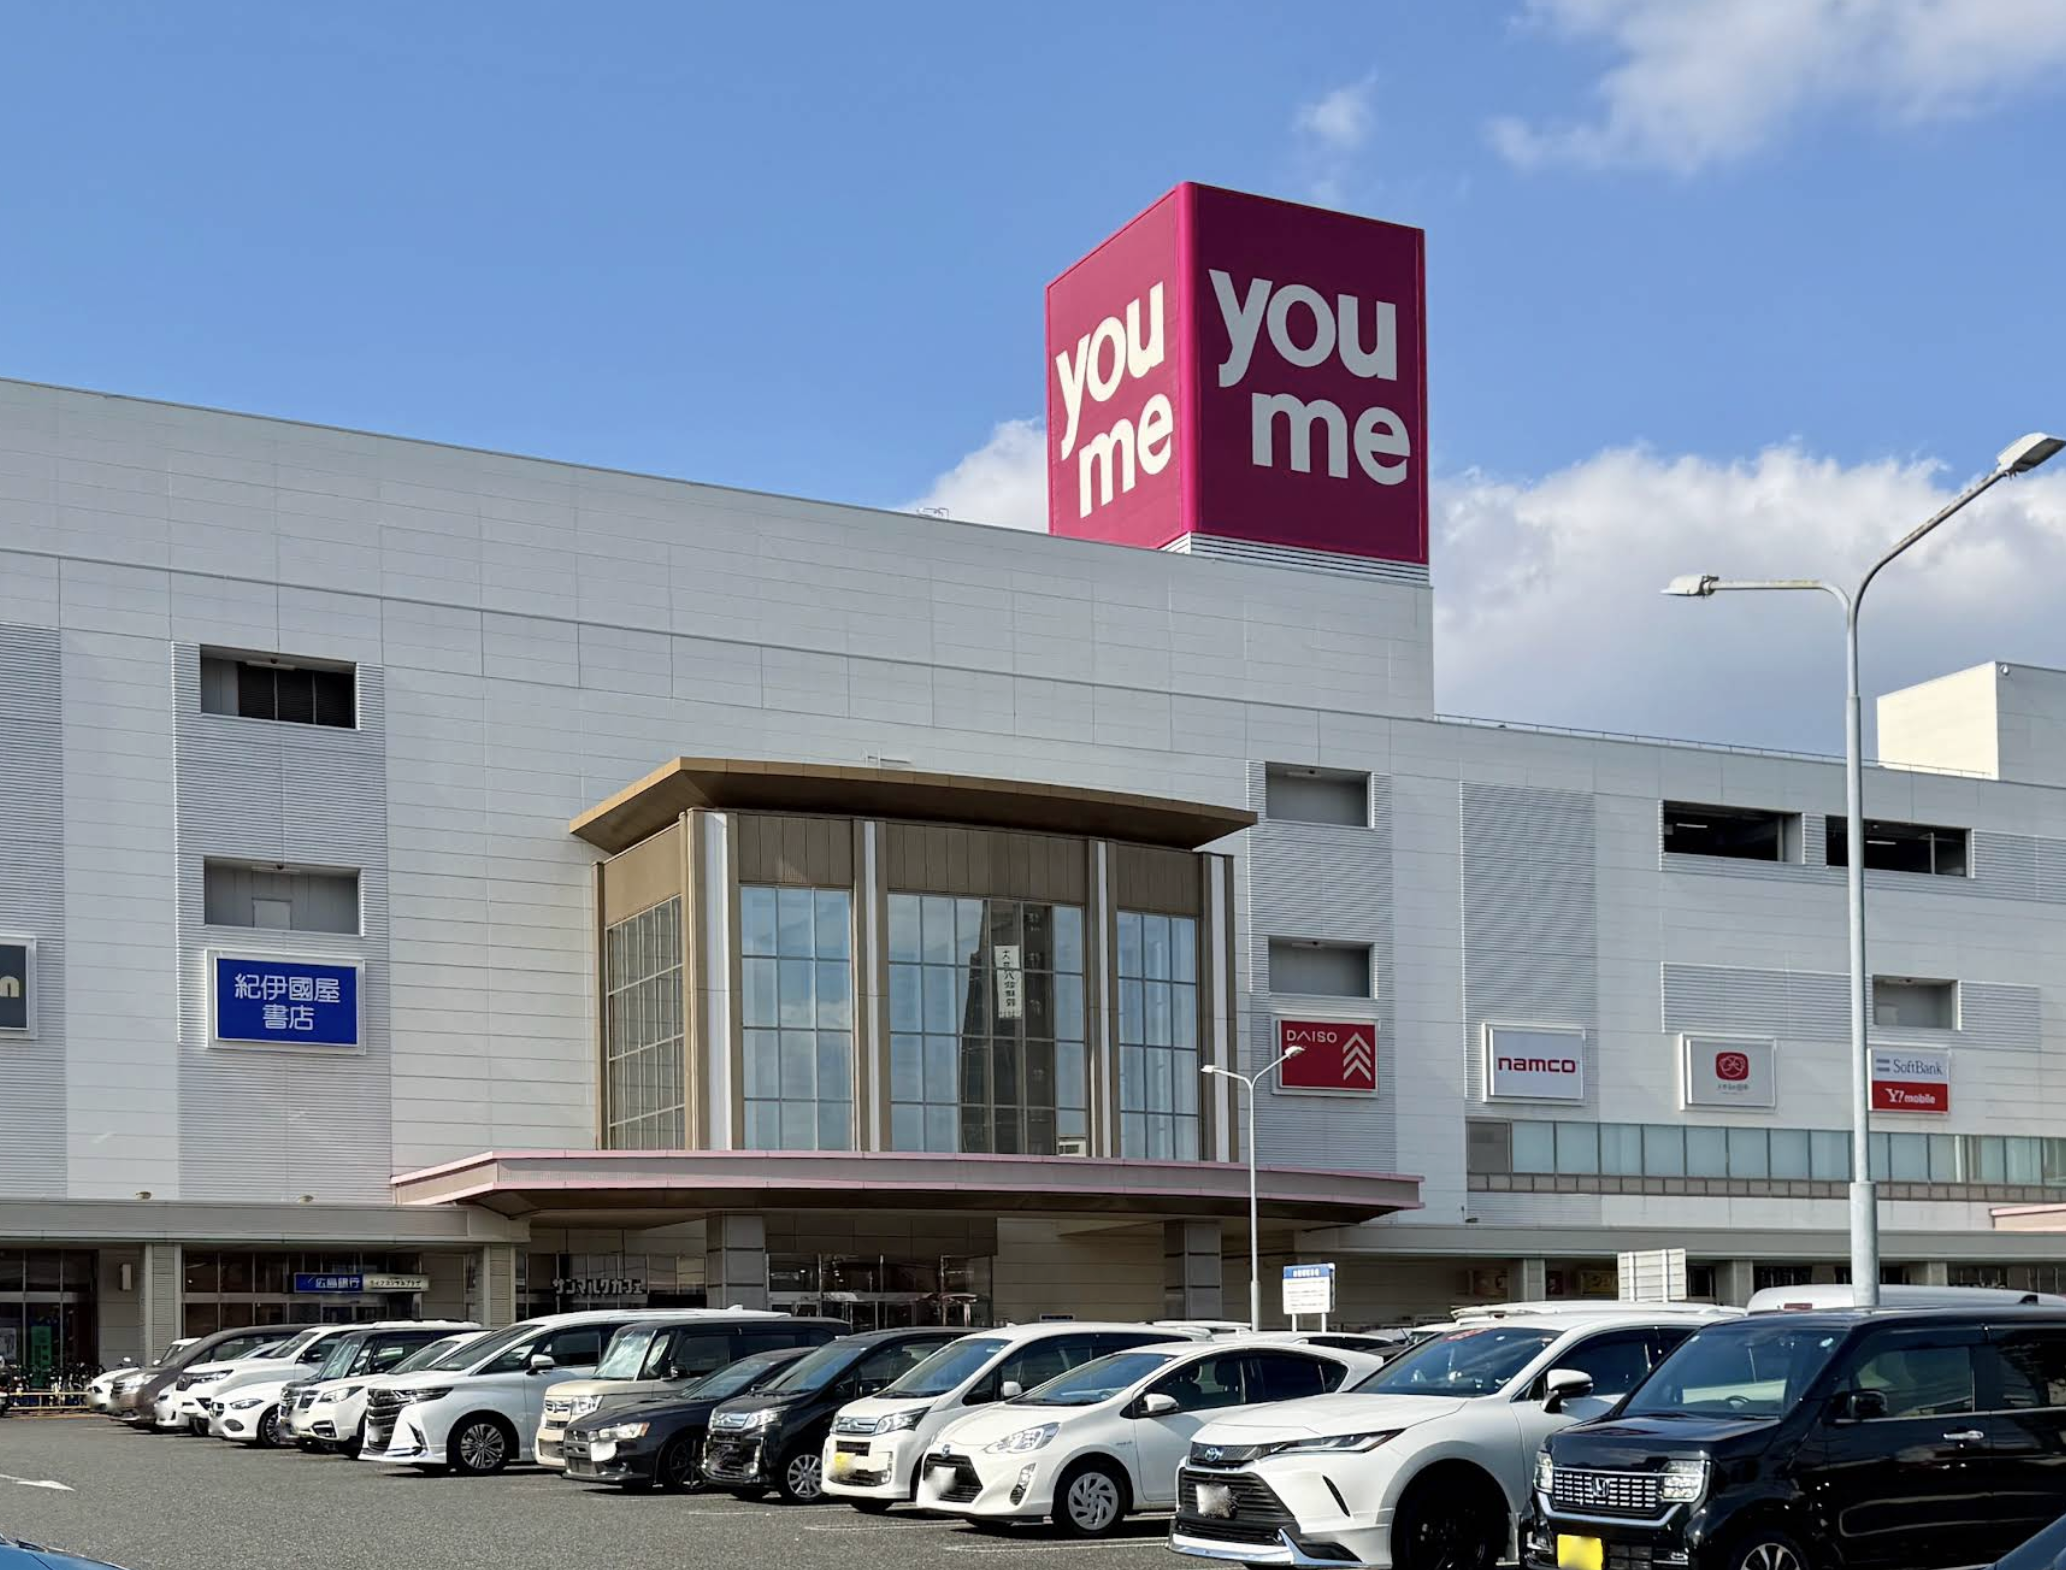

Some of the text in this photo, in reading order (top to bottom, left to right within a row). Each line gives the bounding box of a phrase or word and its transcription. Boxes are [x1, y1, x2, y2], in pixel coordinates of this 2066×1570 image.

[1208, 269, 1397, 388] you
[1055, 281, 1165, 461] you
[1252, 392, 1411, 486] me
[1079, 393, 1174, 519] me
[234, 973, 341, 1003] 紀伊國屋
[262, 1004, 315, 1030] 書店
[1286, 1029, 1338, 1043] DAISO
[1498, 1057, 1576, 1073] namco
[1893, 1059, 1943, 1075] SoftBank
